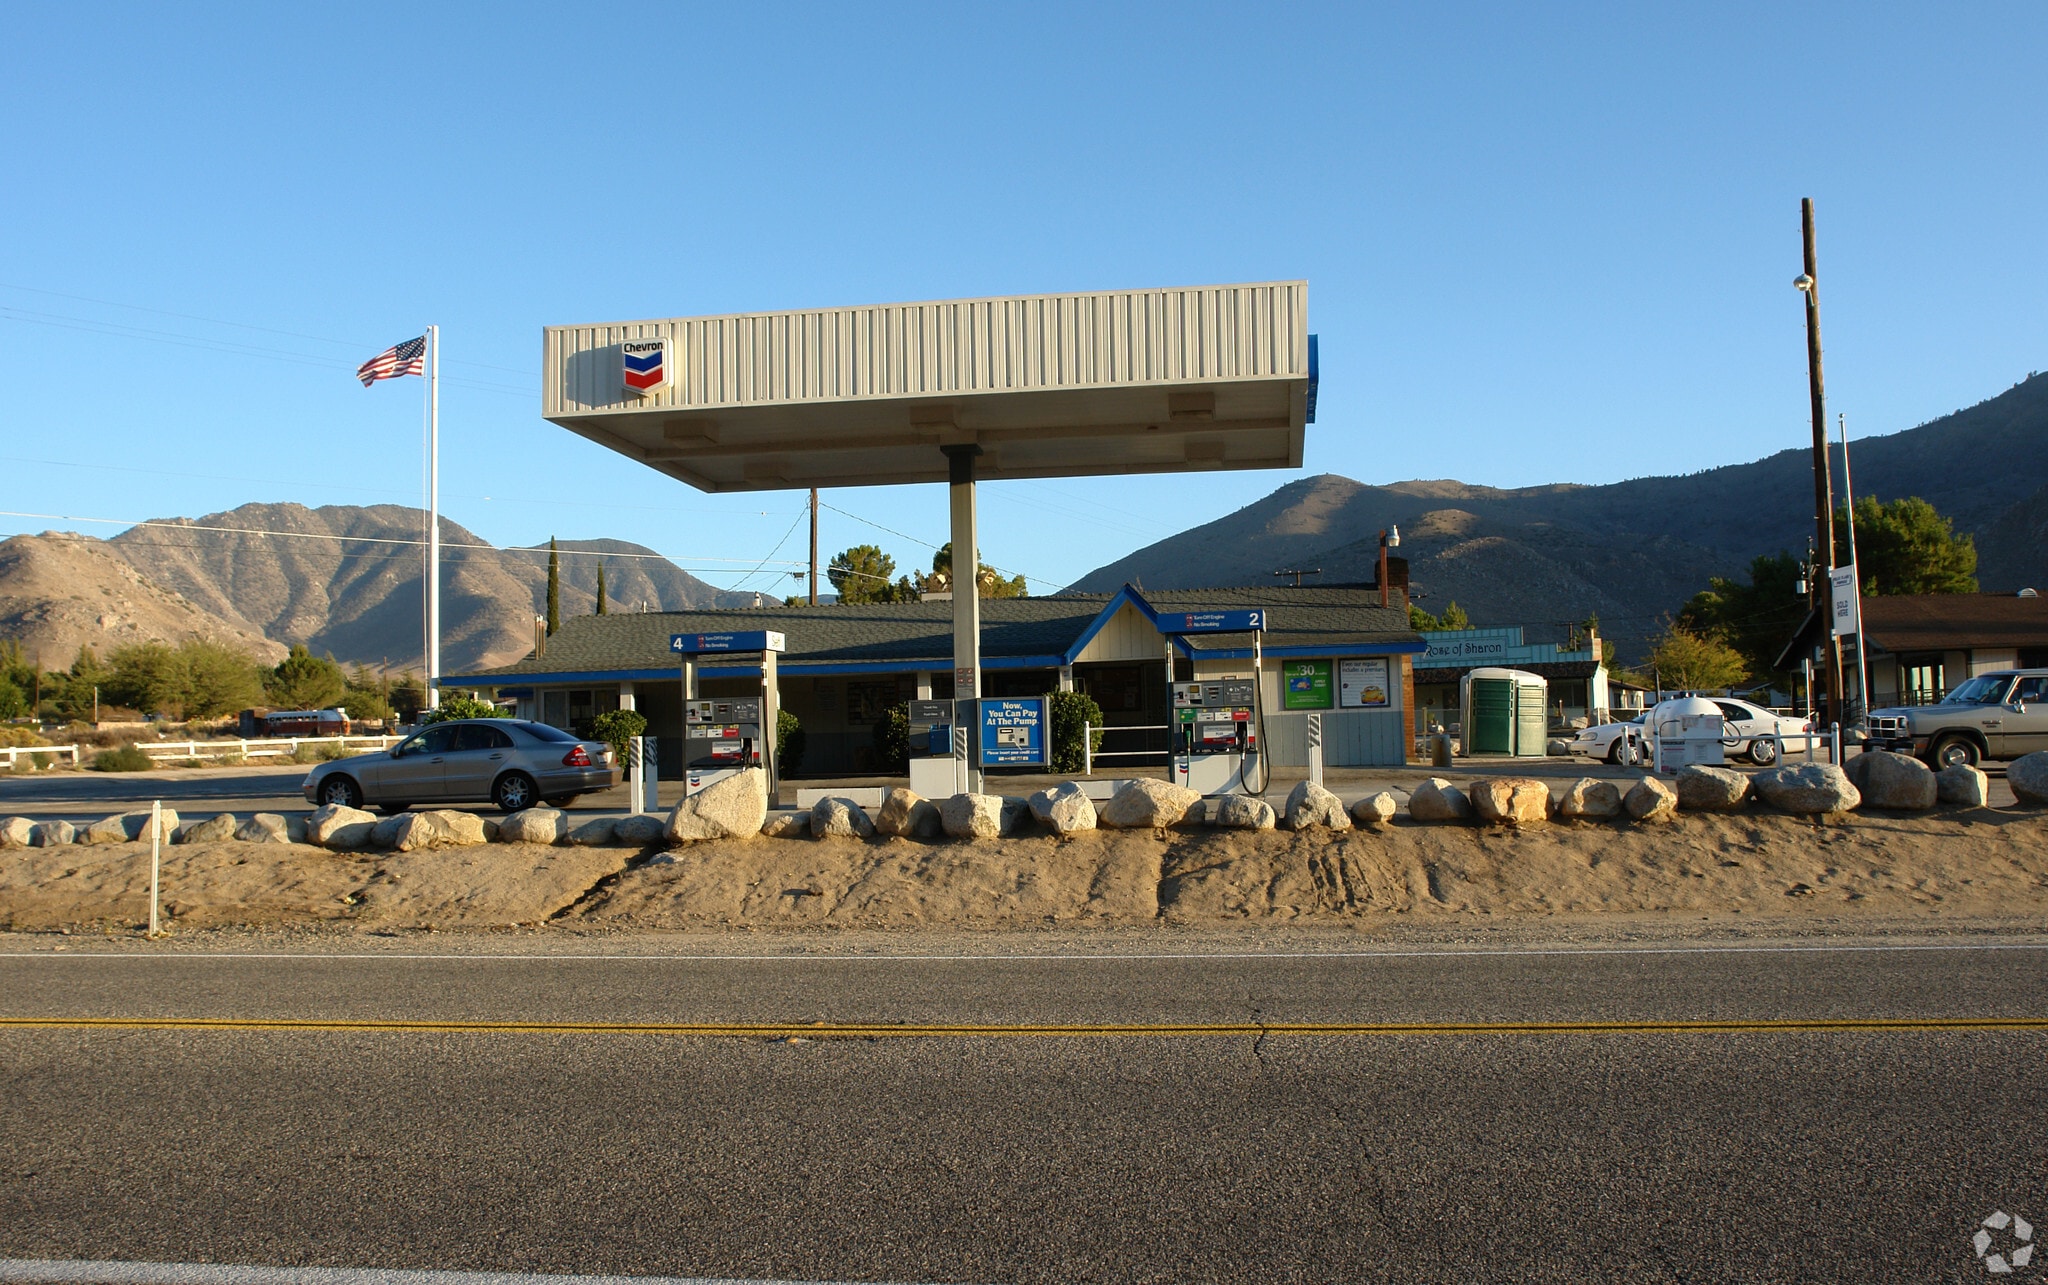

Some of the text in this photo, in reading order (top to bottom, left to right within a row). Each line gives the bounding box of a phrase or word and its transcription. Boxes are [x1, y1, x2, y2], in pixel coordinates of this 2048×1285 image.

[624, 342, 663, 352] Chevron
[1836, 600, 1849, 609] SOLD
[1837, 609, 1849, 617] HERE
[1249, 612, 1259, 626] 2
[673, 637, 683, 650] 4
[1426, 643, 1502, 657] Rose of Sharon
[1002, 702, 1022, 710] Now,
[988, 710, 1004, 718] You
[1022, 709, 1038, 718] Pay
[986, 717, 1040, 726] At The Pump.
